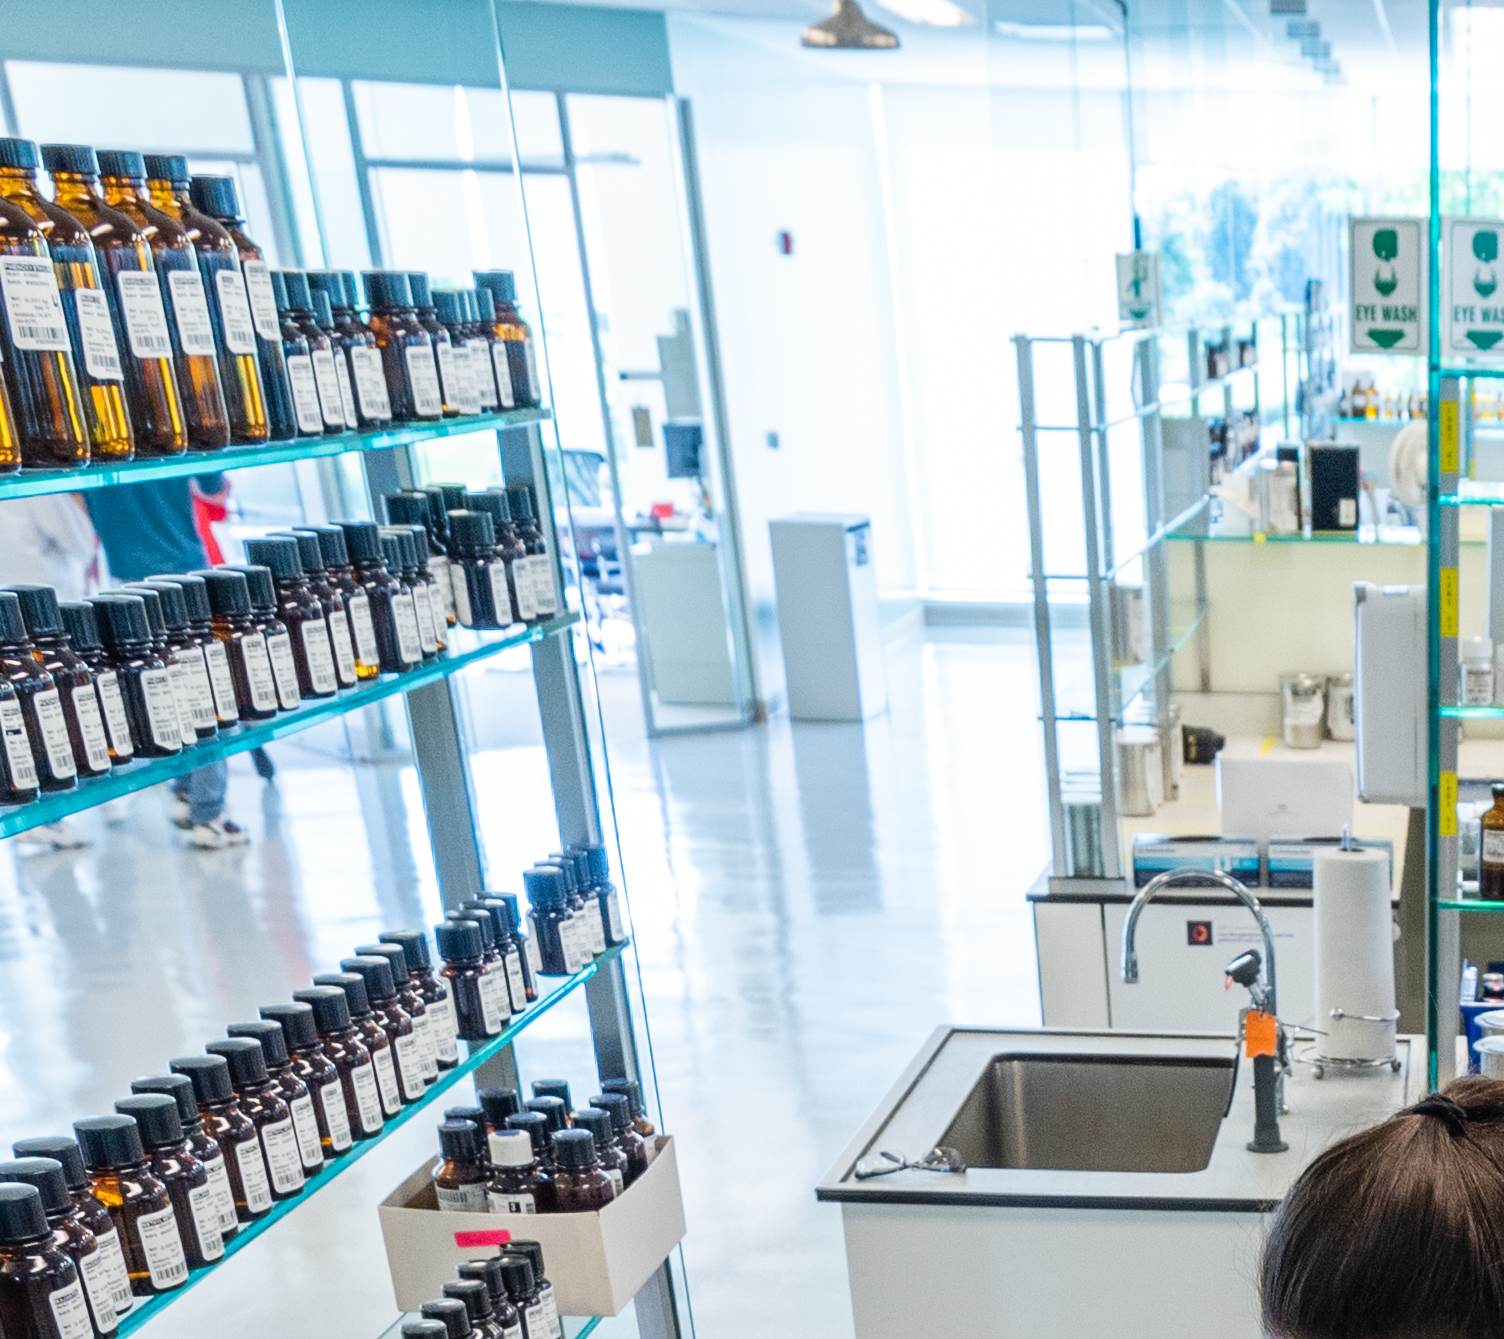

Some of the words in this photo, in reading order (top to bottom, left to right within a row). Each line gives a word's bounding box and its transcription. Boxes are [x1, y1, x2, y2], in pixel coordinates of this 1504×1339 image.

[1355, 304, 1377, 322] EYE
[1381, 305, 1417, 322] WASH
[1454, 306, 1475, 322] EYE
